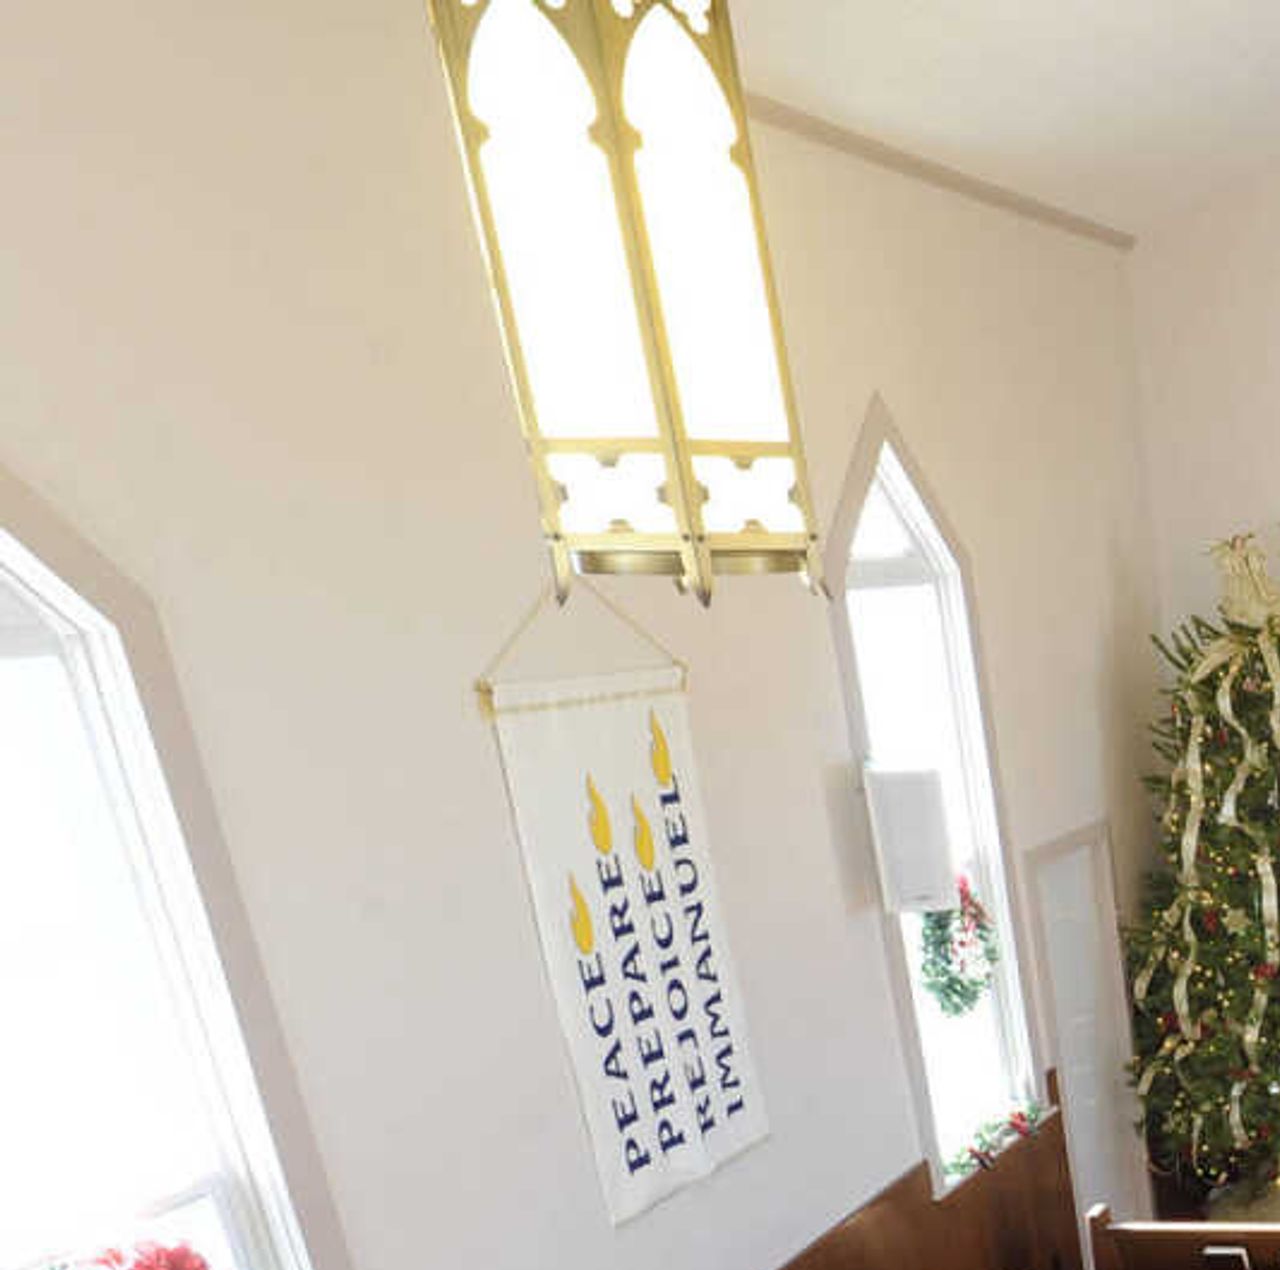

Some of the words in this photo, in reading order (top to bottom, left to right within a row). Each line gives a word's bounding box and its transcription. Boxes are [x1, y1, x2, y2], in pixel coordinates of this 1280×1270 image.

[578, 952, 652, 1175] PEACE
[596, 854, 687, 1154] PREPARE
[640, 868, 717, 1135] REJOICE
[660, 773, 744, 1119] IMMANUEL
